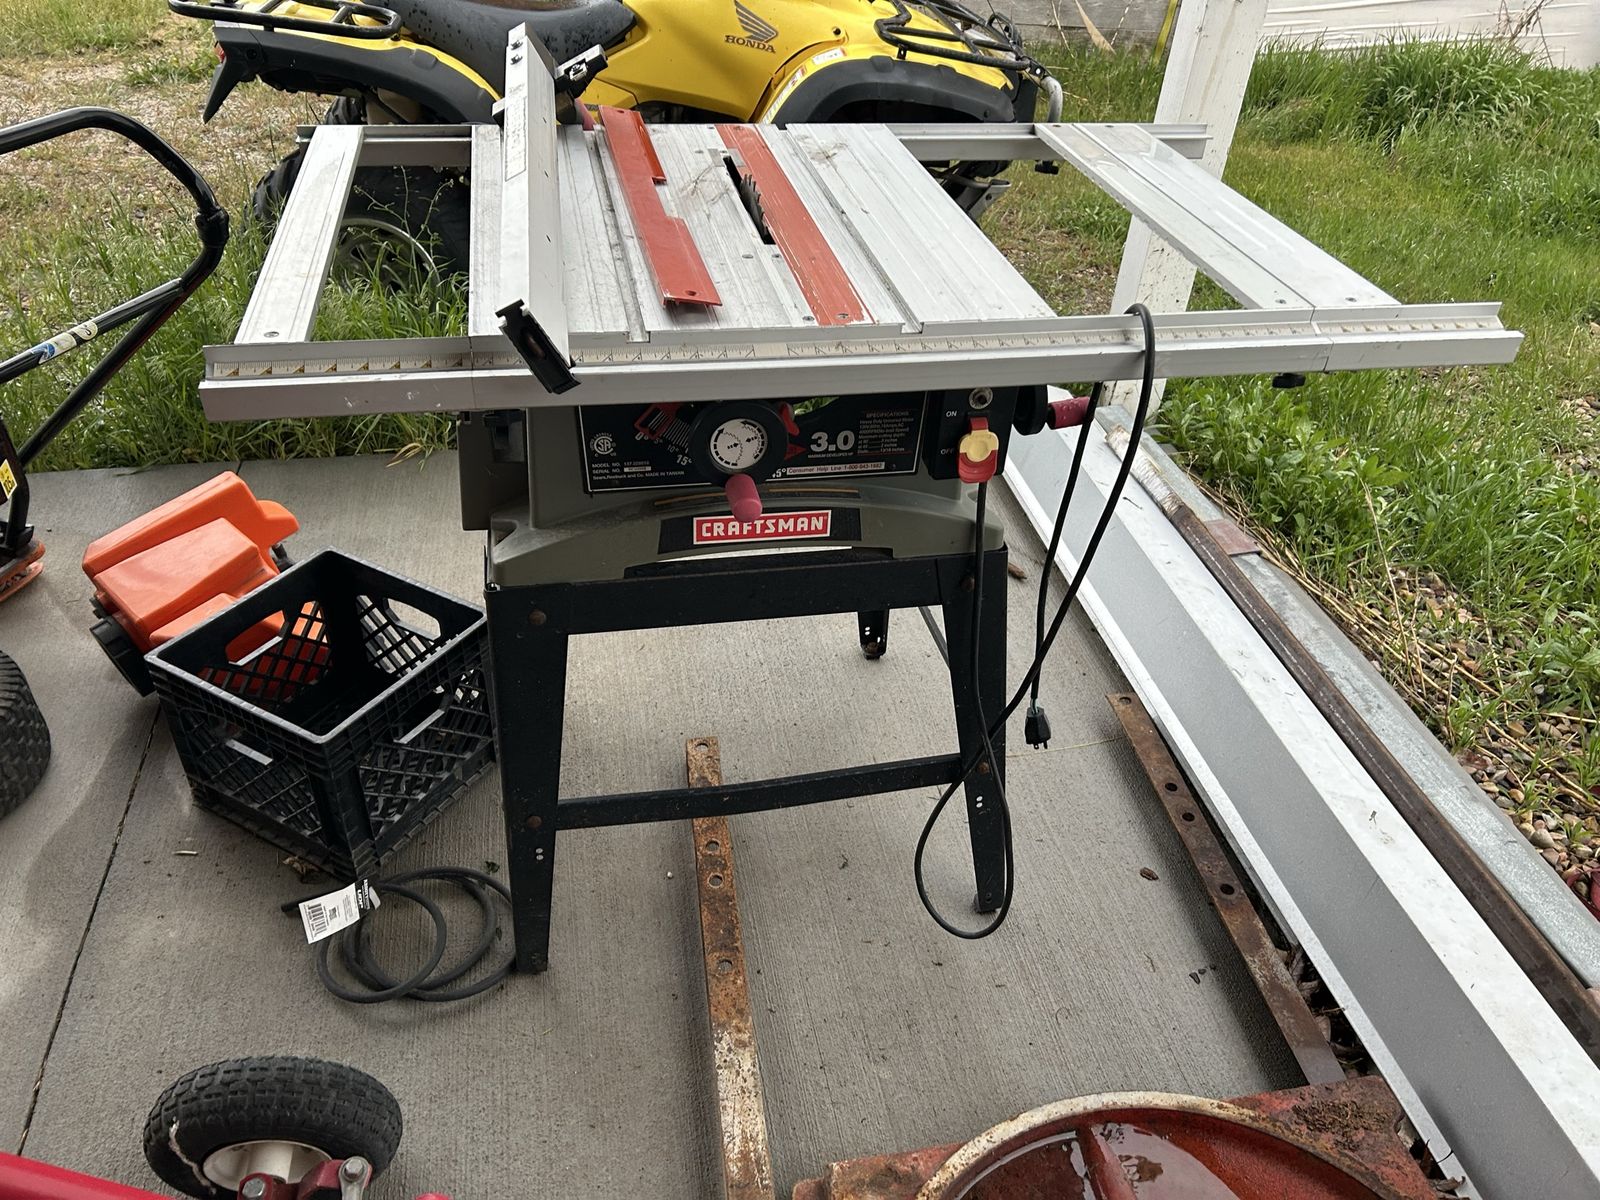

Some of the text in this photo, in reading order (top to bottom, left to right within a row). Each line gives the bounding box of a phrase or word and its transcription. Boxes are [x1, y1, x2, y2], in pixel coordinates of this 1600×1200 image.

[724, 35, 776, 54] HONDA
[945, 410, 958, 418] ON
[809, 430, 855, 452] 3.0
[788, 466, 815, 474] Consumer
[701, 516, 824, 537] CRAFTSMAN
